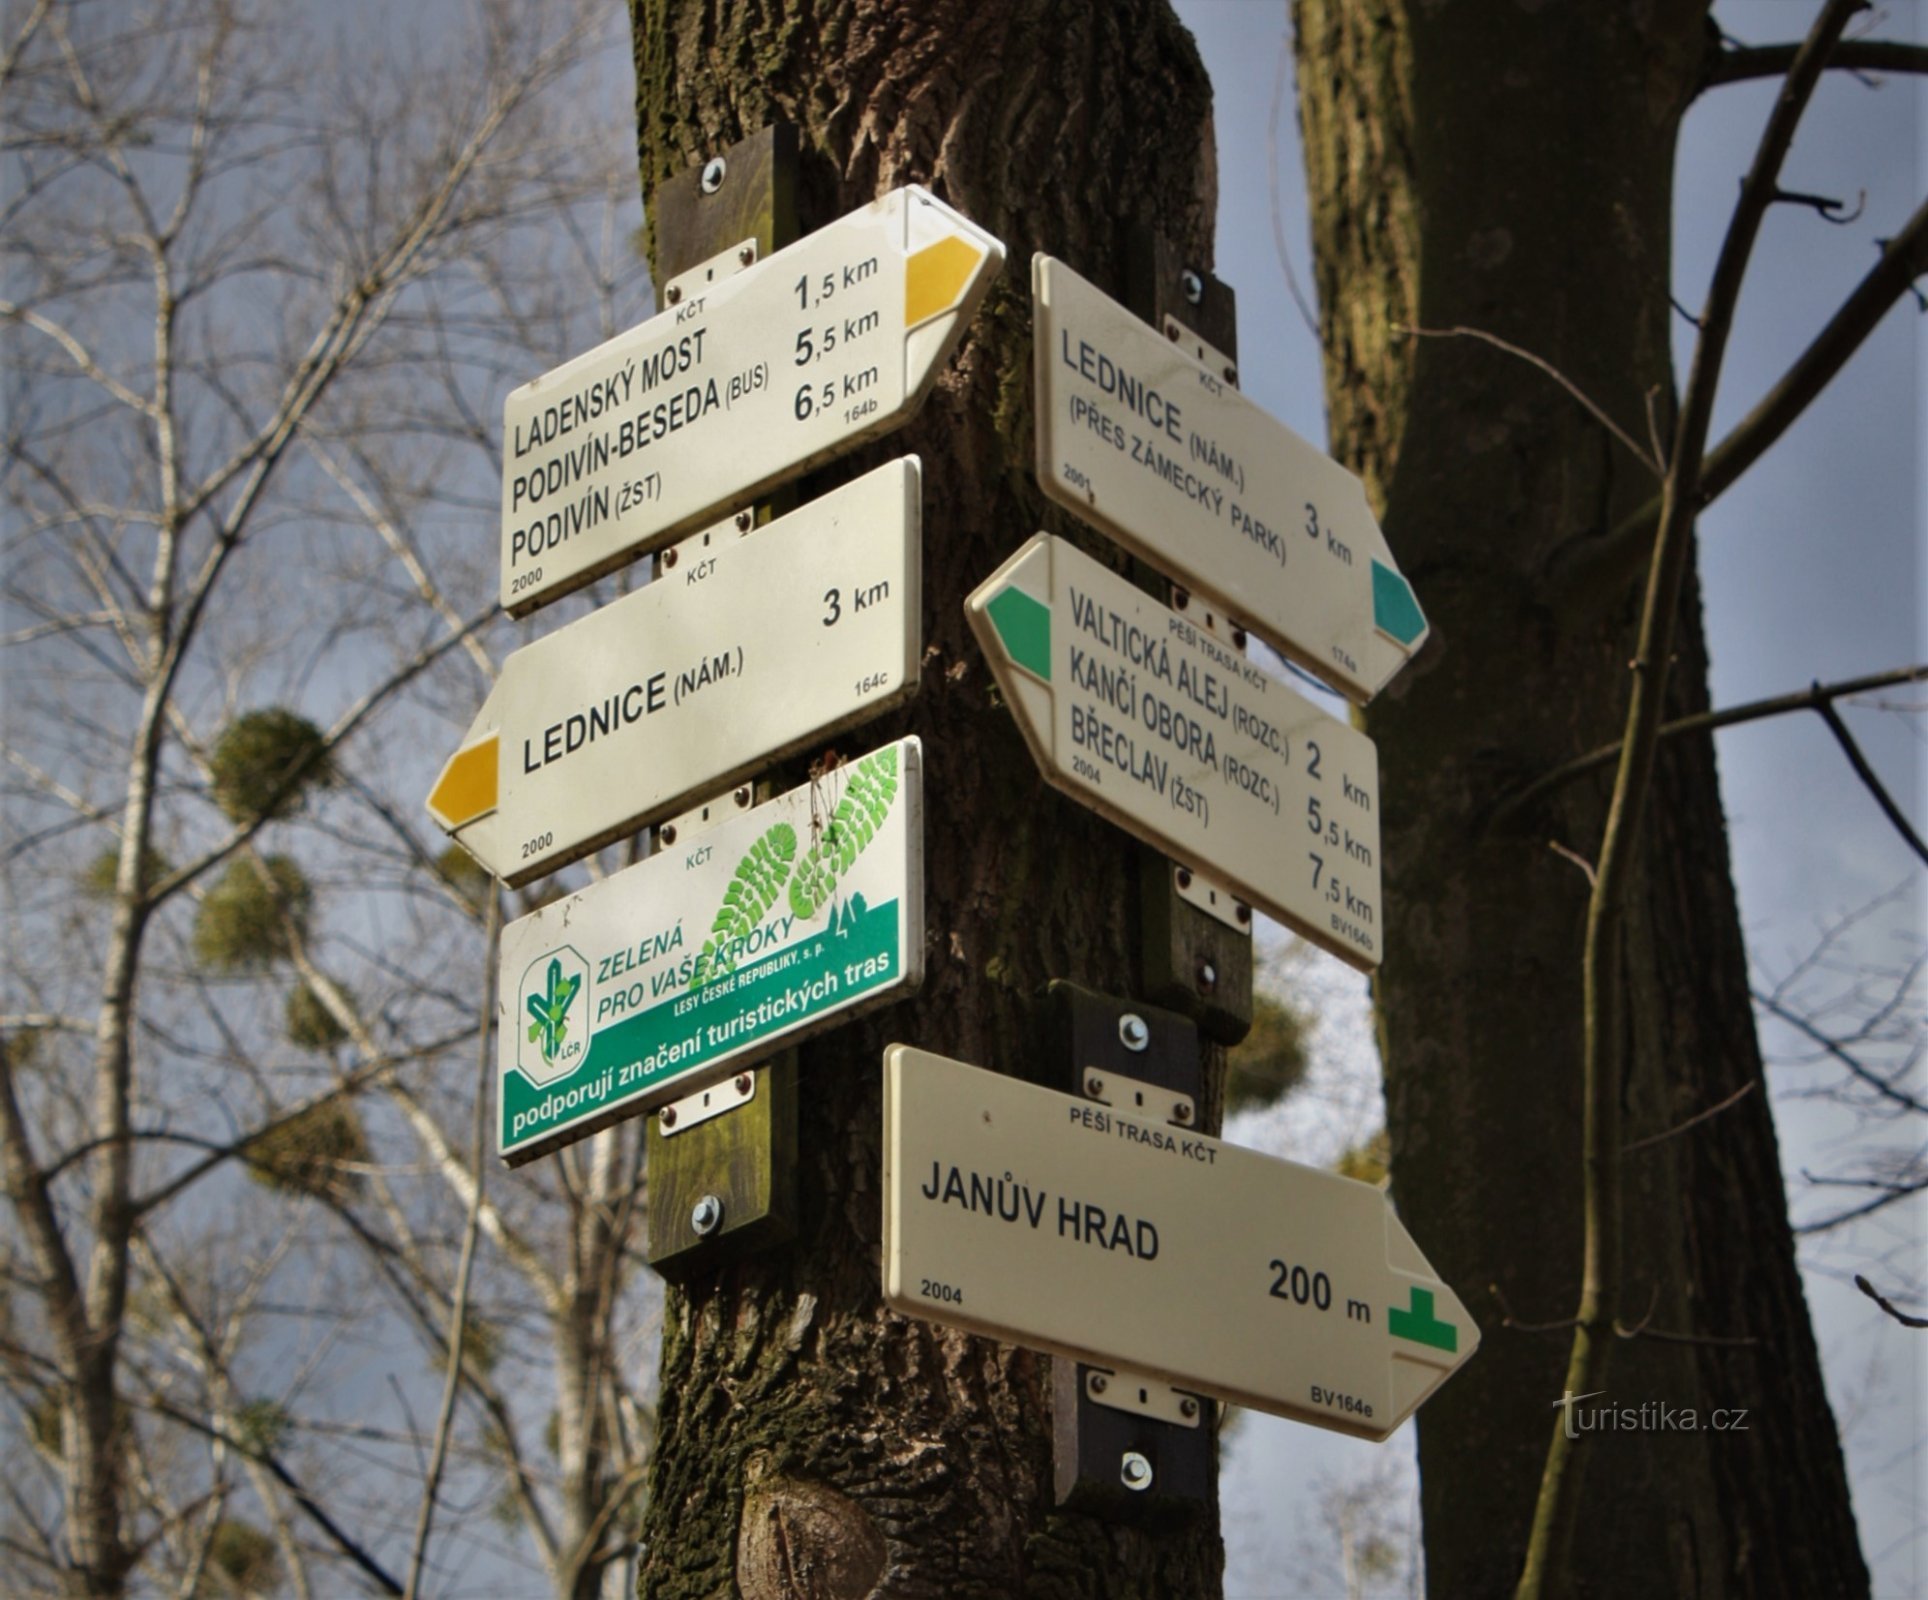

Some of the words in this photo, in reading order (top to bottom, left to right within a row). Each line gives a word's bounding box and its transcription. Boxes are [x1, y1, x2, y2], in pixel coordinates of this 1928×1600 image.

[676, 297, 707, 325] KČT
[515, 358, 636, 458] LADENSKÝ
[642, 328, 707, 395] MOST
[794, 273, 834, 311] 1,5
[844, 256, 878, 289] km
[1200, 371, 1223, 398] KČT
[513, 378, 721, 513] PODIVÍN-BESEDA
[726, 361, 769, 407] (BUS)
[795, 327, 835, 367] 5,5
[844, 309, 879, 342] km
[844, 398, 878, 424] 164b
[1062, 329, 1182, 444] LEDNICE
[1190, 433, 1244, 494] (NÁM.)
[512, 486, 609, 567] PODIVÍN
[615, 471, 661, 521] (ŽST)
[795, 380, 835, 422] 6,5
[844, 363, 878, 397] km
[1070, 395, 1124, 451] (PŘES
[1132, 435, 1222, 516] ZÁMECKÝ
[1231, 509, 1286, 567] PARK)
[1305, 503, 1319, 539] 3
[1328, 530, 1351, 564] km
[512, 567, 542, 595] 2000
[686, 557, 717, 585] KČT
[823, 588, 840, 626] 3
[855, 579, 889, 613] km
[855, 670, 887, 696] 164c
[1169, 618, 1196, 648] PĚŠÍ
[1200, 639, 1240, 675] TRASA
[1244, 662, 1267, 692] KČT
[524, 672, 667, 775] LEDNICE
[674, 646, 743, 706] (NÁM.)
[1070, 586, 1171, 686] VALTICKÁ
[1178, 660, 1228, 719] ALEJ
[1232, 703, 1289, 765] (ROZC.)
[1306, 742, 1321, 779] 2
[1343, 774, 1370, 810] km
[1071, 646, 1137, 719] KANČÍ
[1143, 693, 1218, 771] OBORA
[1223, 753, 1279, 815] (ROZC.)
[1308, 797, 1339, 848] 5,5
[1345, 830, 1370, 867] km
[1073, 756, 1100, 784] 2004
[1073, 704, 1167, 795] BŘECLAV
[1171, 774, 1209, 828] (ŽST)
[1309, 852, 1340, 903] 7,5
[1346, 887, 1372, 923] km
[522, 832, 552, 859] 2000
[686, 846, 712, 870] KČT
[597, 918, 683, 984] ZELENÁ
[597, 983, 644, 1023] PRO
[650, 953, 709, 1002] VAŠE
[712, 915, 795, 968] KROKY
[674, 995, 699, 1017] LESY
[702, 974, 734, 1004] ČESKÉ
[513, 1066, 613, 1137] podporují
[619, 1030, 701, 1086] značení
[707, 970, 838, 1043] turistických
[844, 951, 890, 984] tras
[1070, 1107, 1111, 1134] PĚŠÍ
[1117, 1119, 1176, 1153] TRASA
[1182, 1138, 1217, 1164] KČT
[922, 1162, 1045, 1230] JANŮV
[1058, 1197, 1159, 1261] HRAD
[921, 1279, 962, 1305] 2004
[1269, 1259, 1330, 1311] 200
[1347, 1298, 1370, 1323] m
[1311, 1386, 1373, 1417] BV164e
